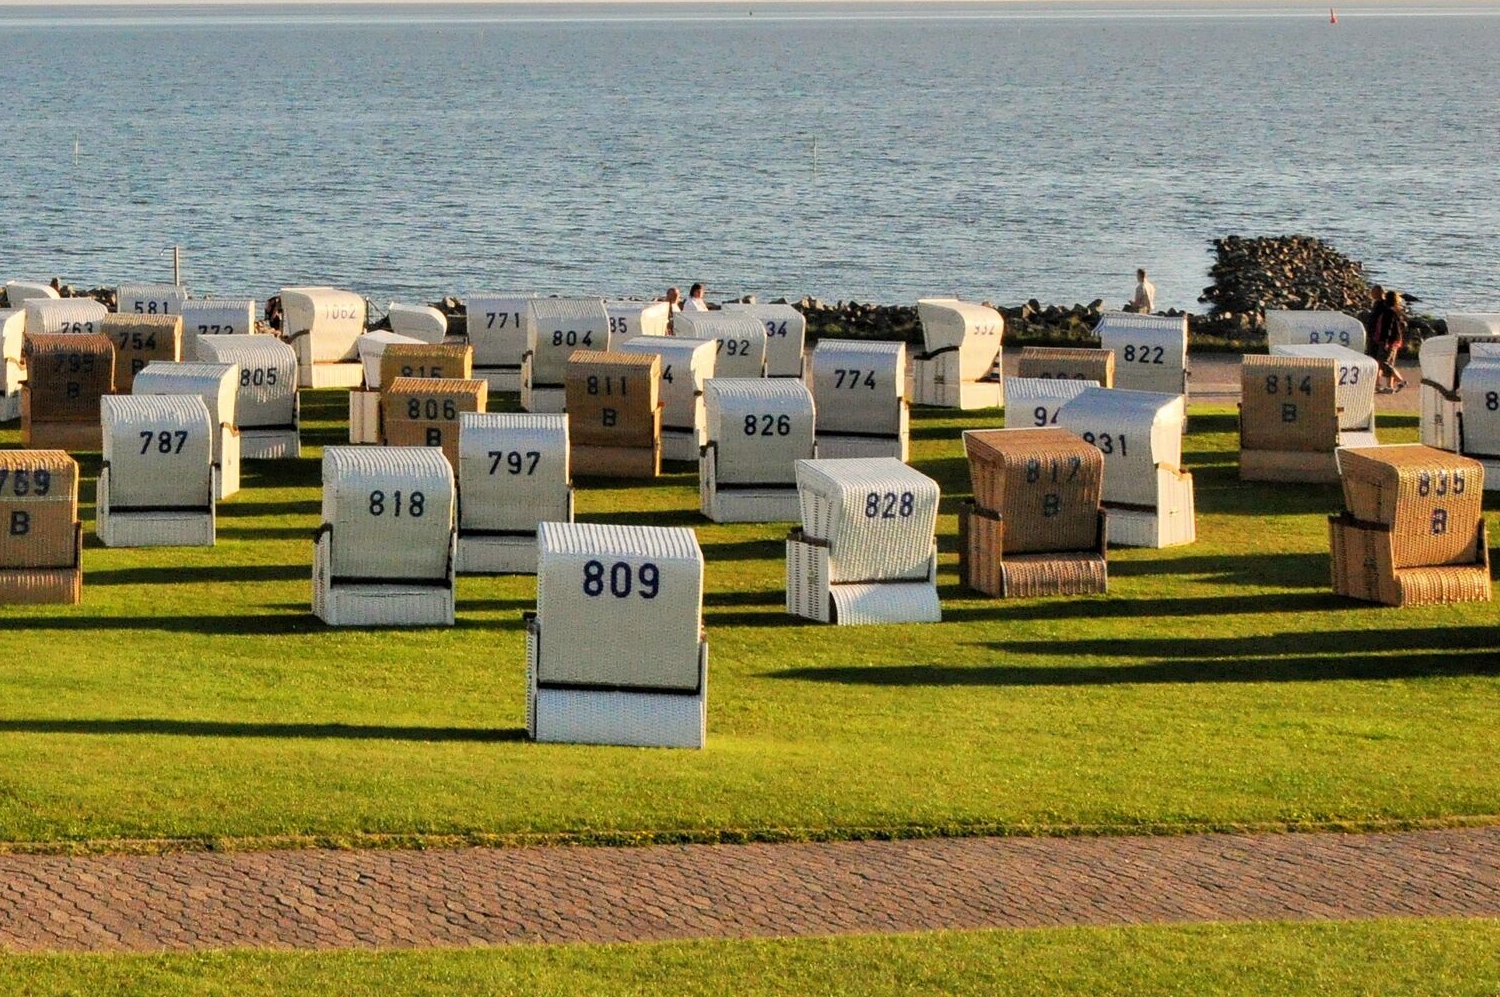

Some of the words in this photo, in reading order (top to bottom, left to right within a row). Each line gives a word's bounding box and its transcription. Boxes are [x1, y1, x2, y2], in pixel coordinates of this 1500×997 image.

[135, 301, 168, 314] 581
[487, 312, 520, 329] 771
[766, 321, 787, 337] 34
[119, 333, 155, 350] 754
[553, 331, 591, 346] 804
[1124, 346, 1163, 363] 822
[240, 368, 276, 385] 805
[835, 370, 875, 389] 774
[1339, 367, 1359, 385] 23
[587, 377, 627, 395] 811
[1266, 376, 1311, 395] 814
[409, 398, 455, 419] 806
[603, 408, 616, 426] B
[745, 415, 789, 435] 826
[140, 431, 187, 454] 787
[426, 428, 440, 445] B
[488, 451, 540, 474] 797
[370, 491, 424, 517] 818
[866, 493, 914, 517] 828
[11, 512, 29, 535] B
[584, 561, 659, 599] 809
